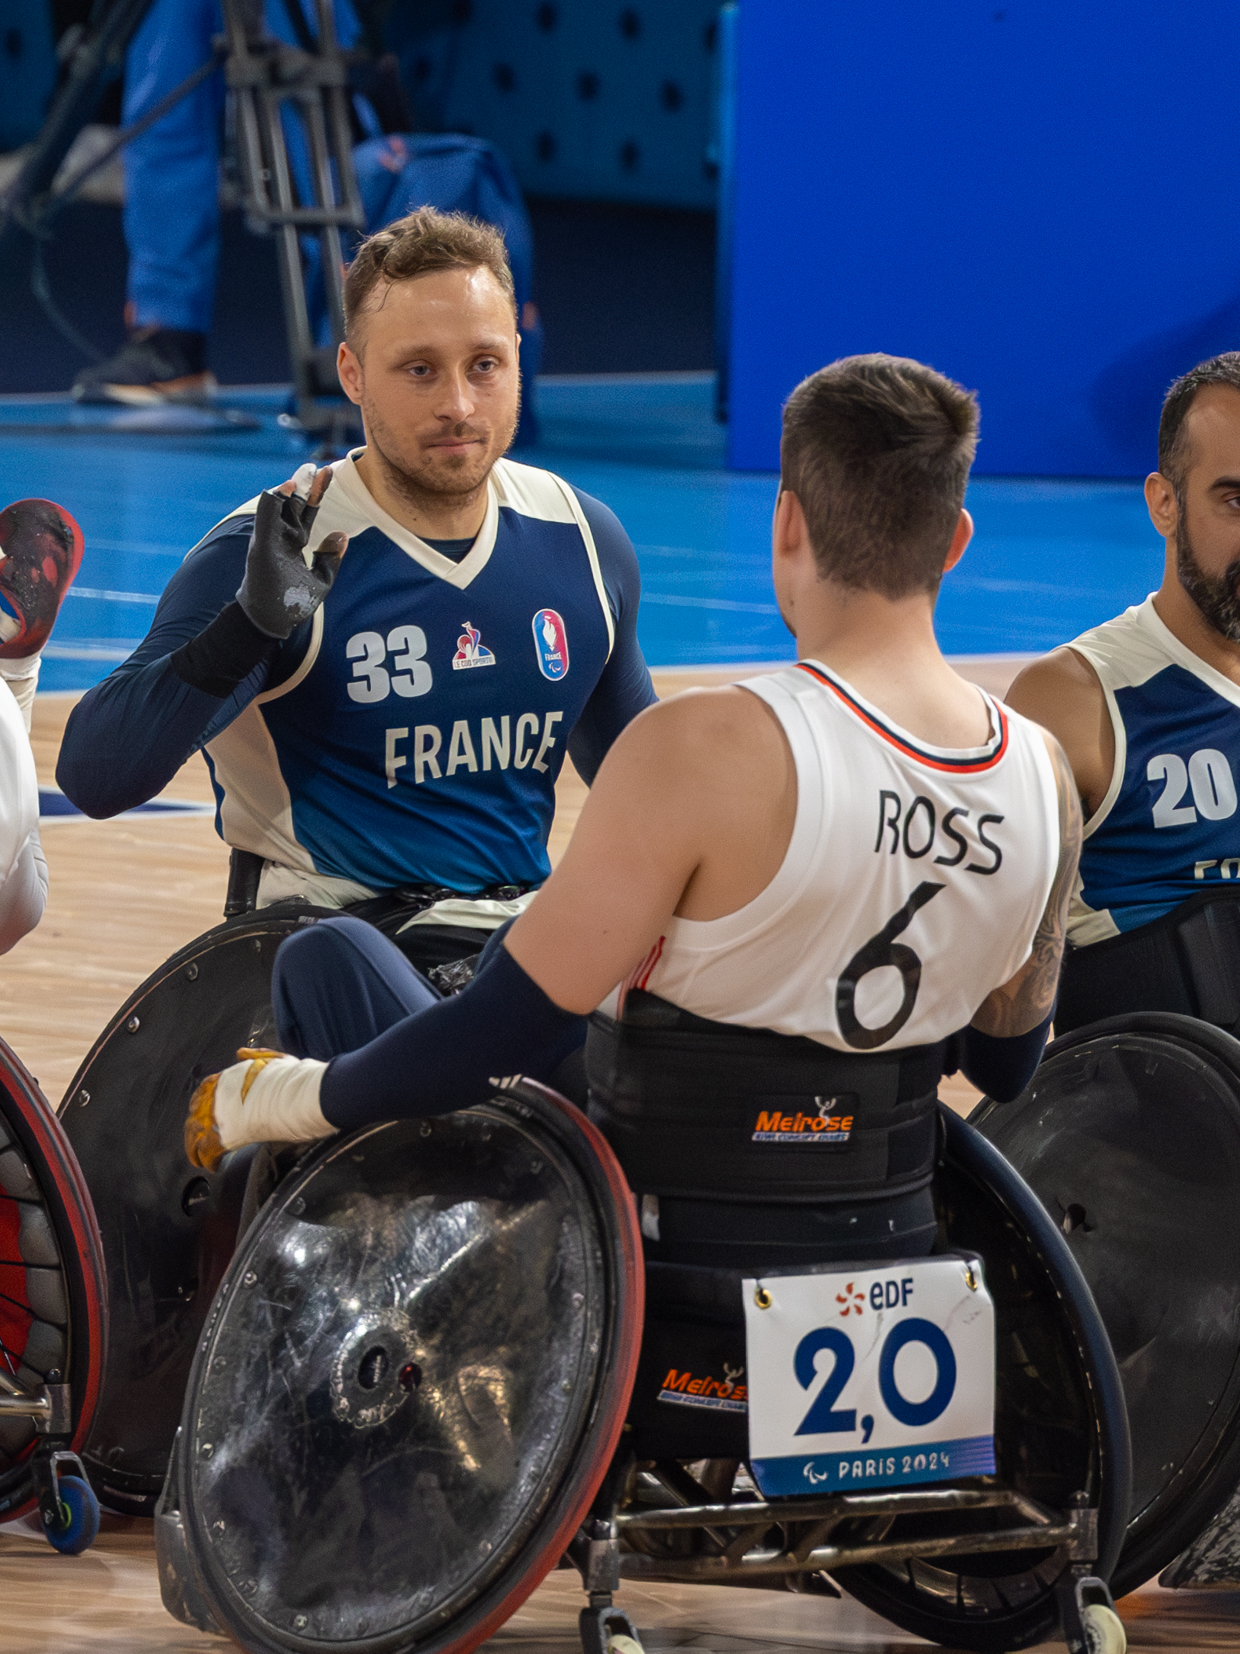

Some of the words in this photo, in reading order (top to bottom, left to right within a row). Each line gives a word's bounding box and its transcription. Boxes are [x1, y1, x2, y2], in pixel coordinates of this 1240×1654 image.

[345, 624, 433, 704] 33
[385, 711, 563, 789] FRANCE
[1146, 748, 1238, 829] 20
[874, 789, 1005, 875] ROSS
[835, 880, 947, 1050] 6
[755, 1110, 854, 1132] Melrose
[662, 1368, 748, 1400] Melros
[793, 1317, 957, 1444] 2,0
[839, 1457, 895, 1479] PARIS
[902, 1452, 949, 1474] 2024
